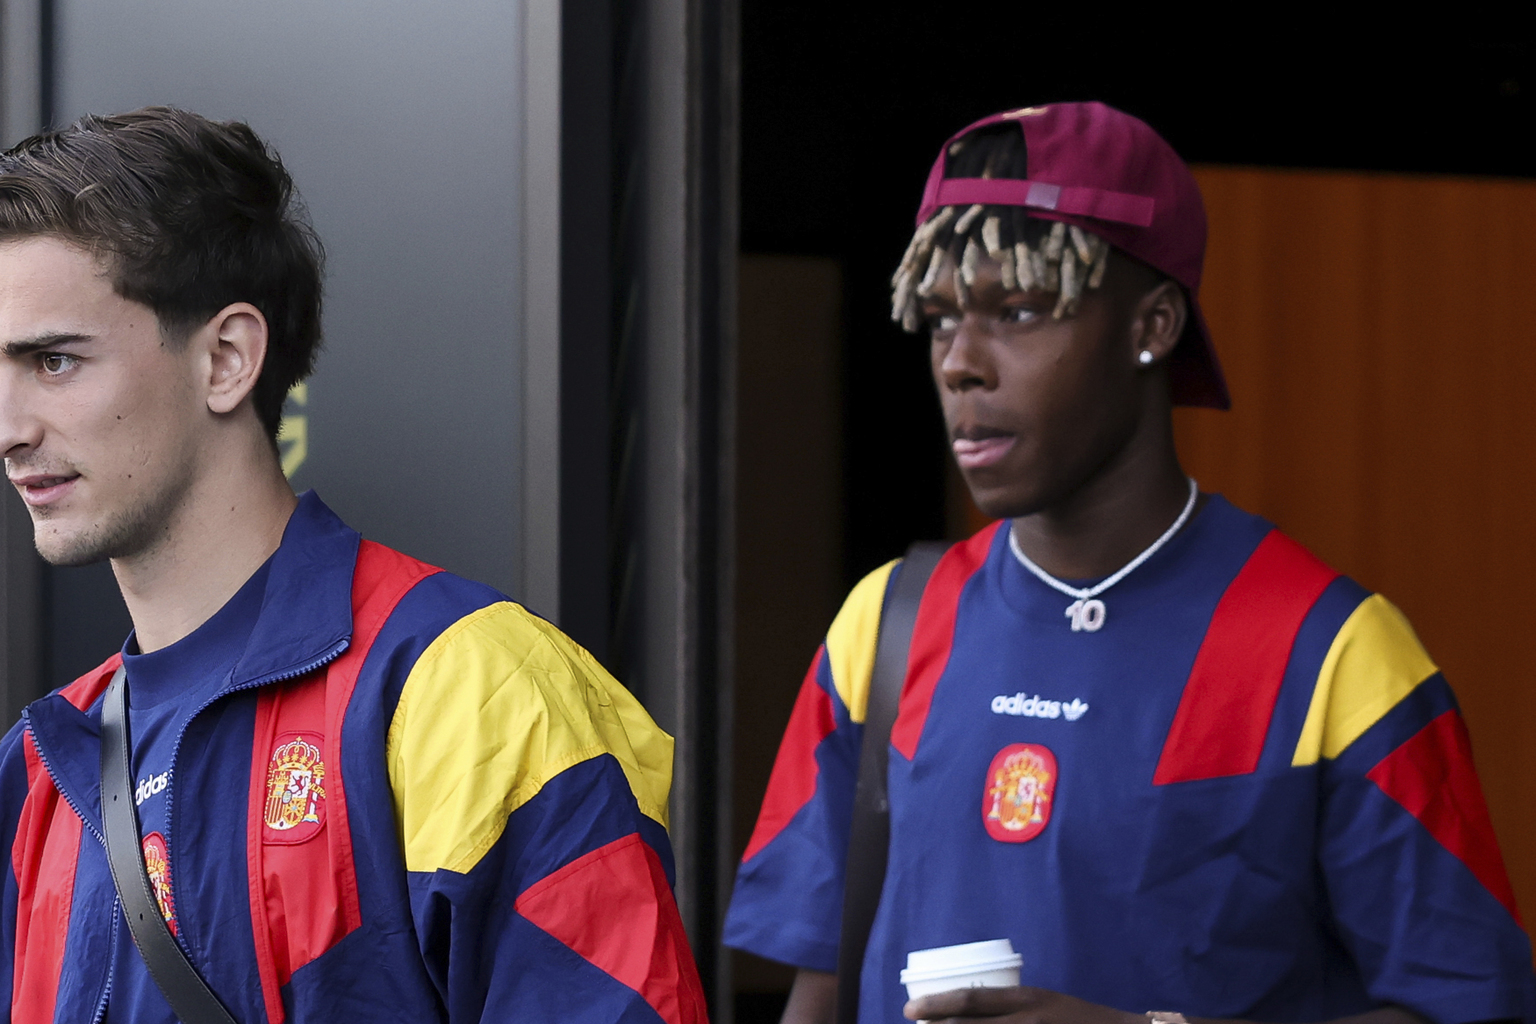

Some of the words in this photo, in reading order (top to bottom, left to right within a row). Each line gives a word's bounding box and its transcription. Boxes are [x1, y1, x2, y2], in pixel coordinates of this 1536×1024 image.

[1065, 599, 1106, 632] 10
[991, 692, 1061, 719] adidas
[135, 771, 168, 806] didas
